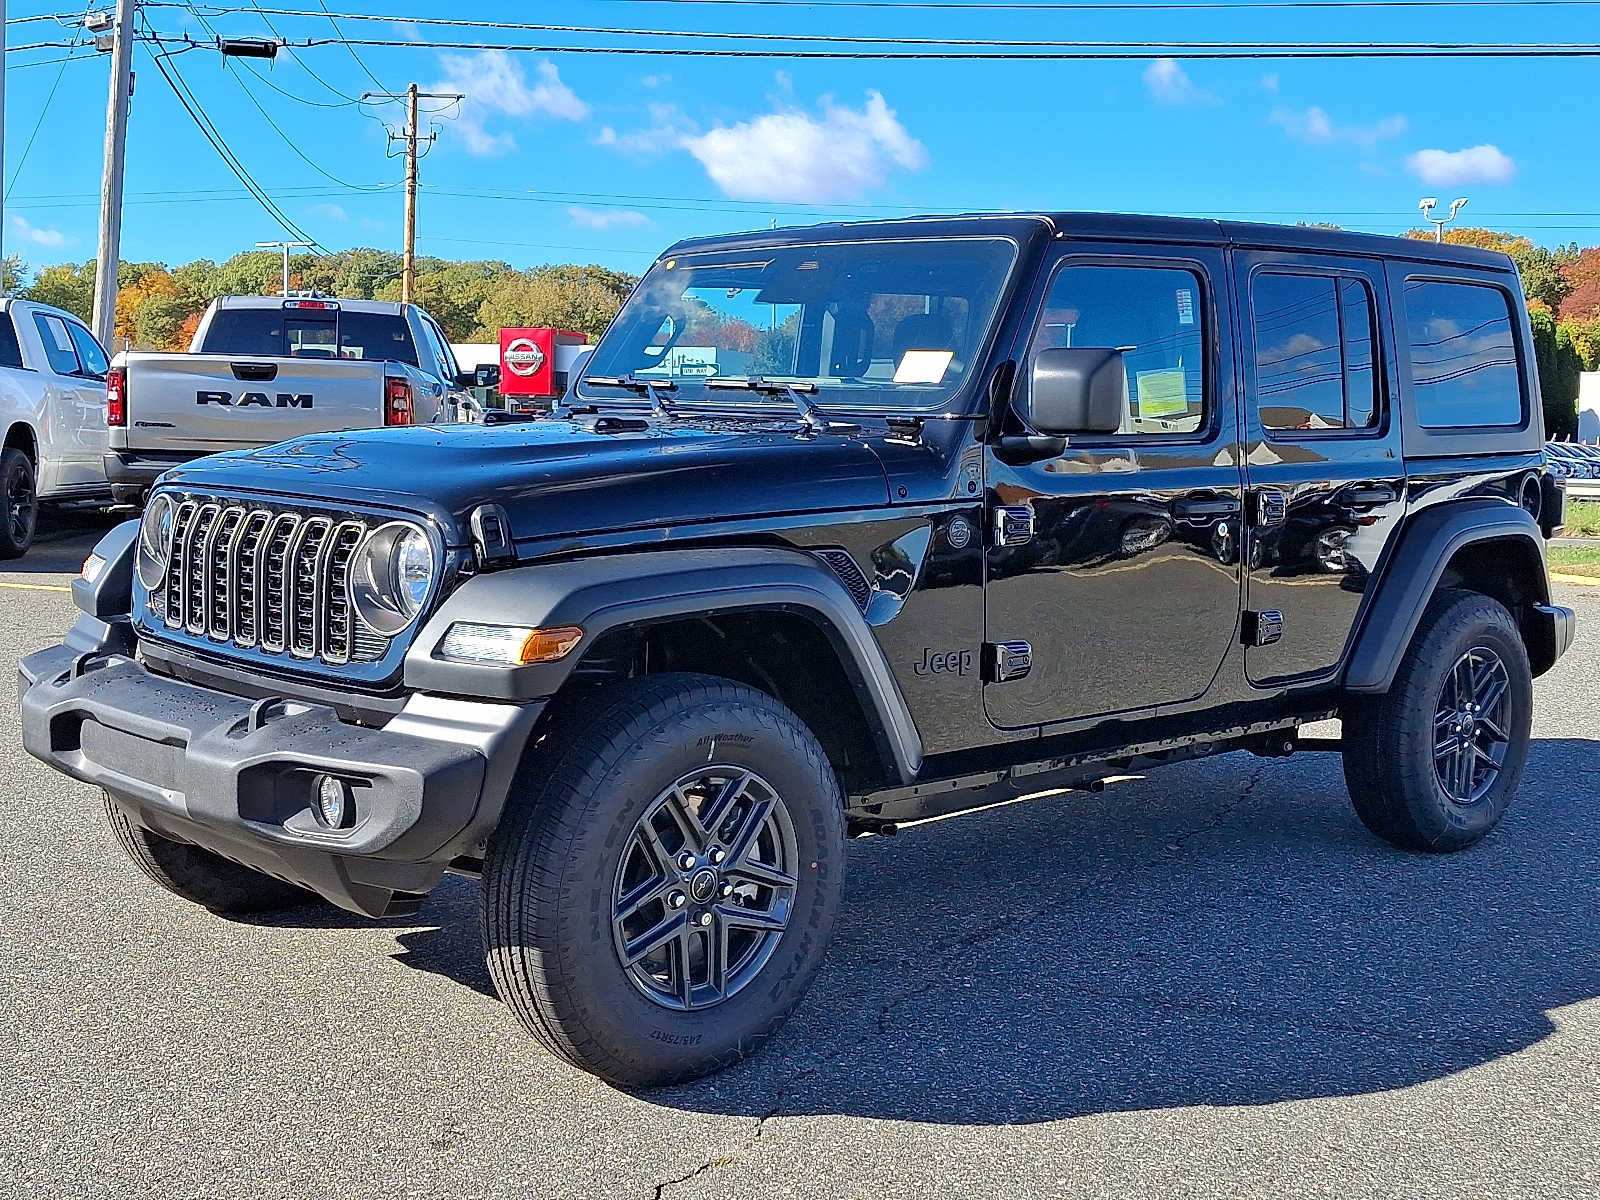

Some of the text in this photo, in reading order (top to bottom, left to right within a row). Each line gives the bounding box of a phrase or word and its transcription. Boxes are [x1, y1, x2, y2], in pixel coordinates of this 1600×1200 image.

[504, 353, 538, 361] NISSAN
[196, 391, 314, 409] RAM
[913, 647, 971, 677] Jeep
